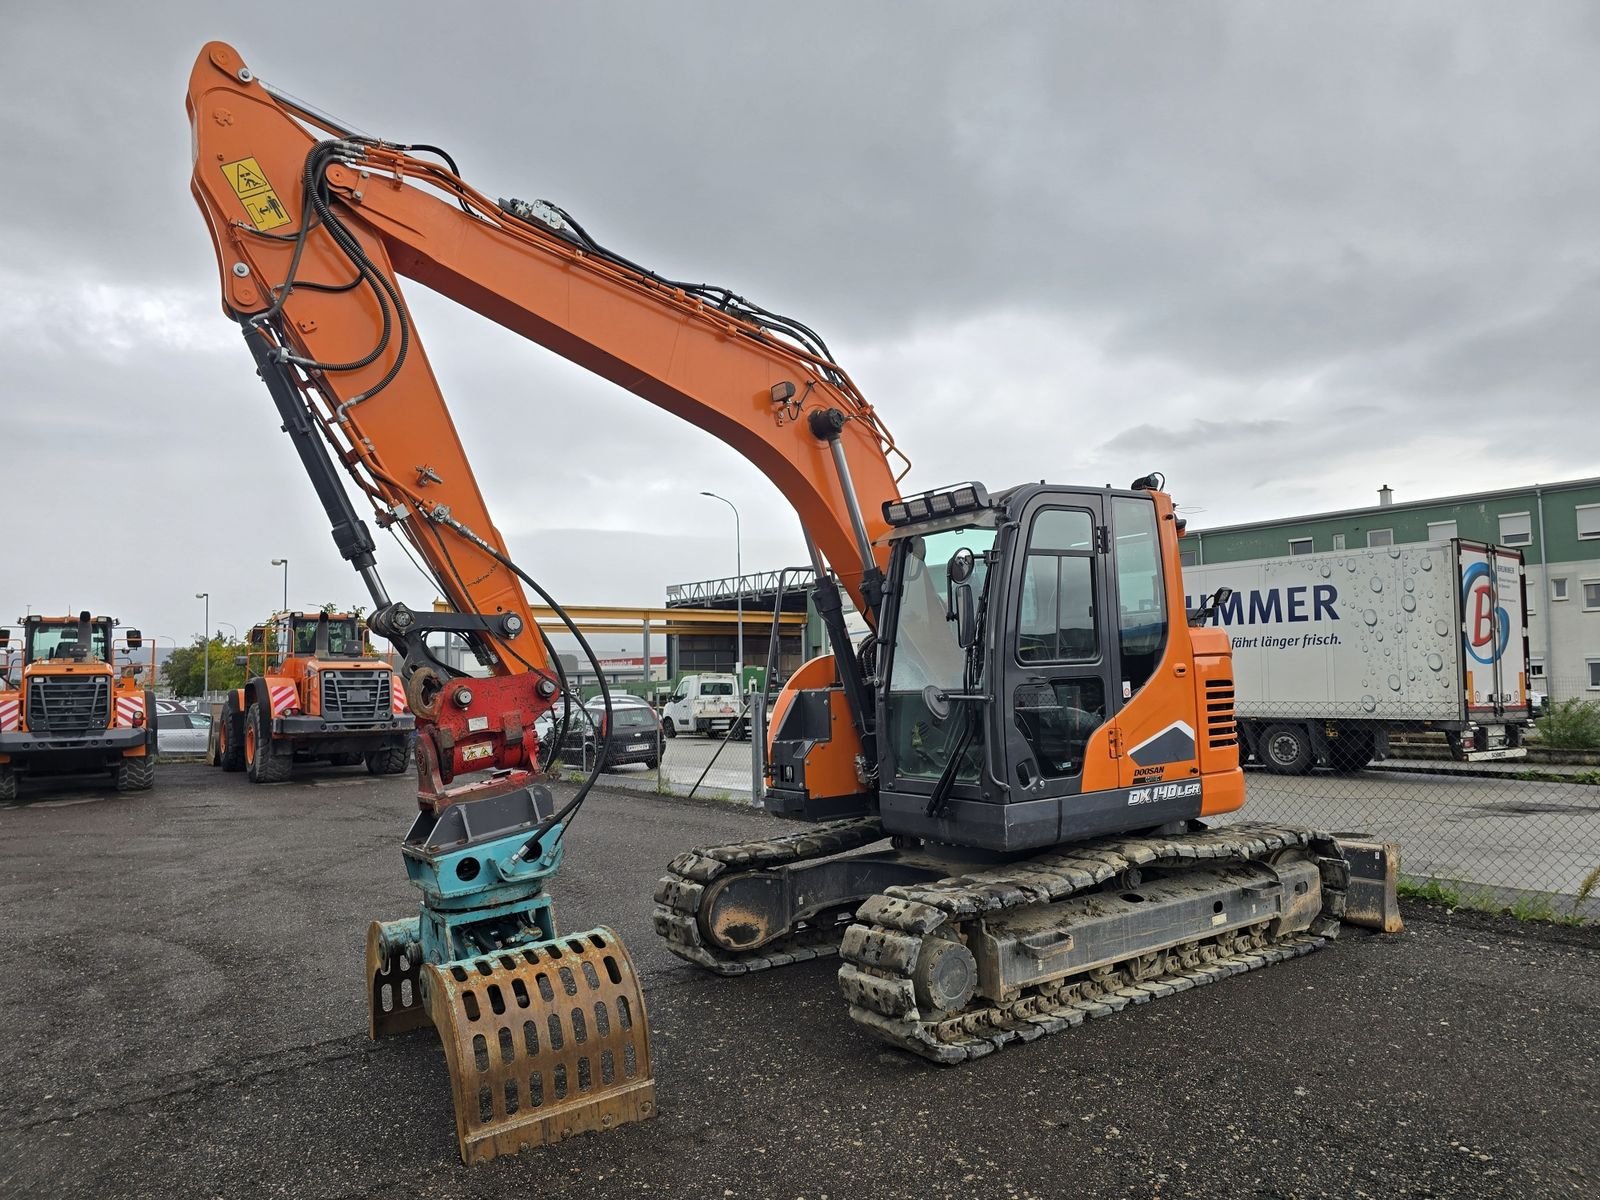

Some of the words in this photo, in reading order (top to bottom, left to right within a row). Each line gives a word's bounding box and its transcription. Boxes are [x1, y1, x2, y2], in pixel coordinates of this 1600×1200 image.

[1231, 637, 1258, 650] fährt
[1261, 635, 1301, 650] länger
[1302, 633, 1342, 648] frisch.
[1134, 766, 1165, 777] DOOSAN
